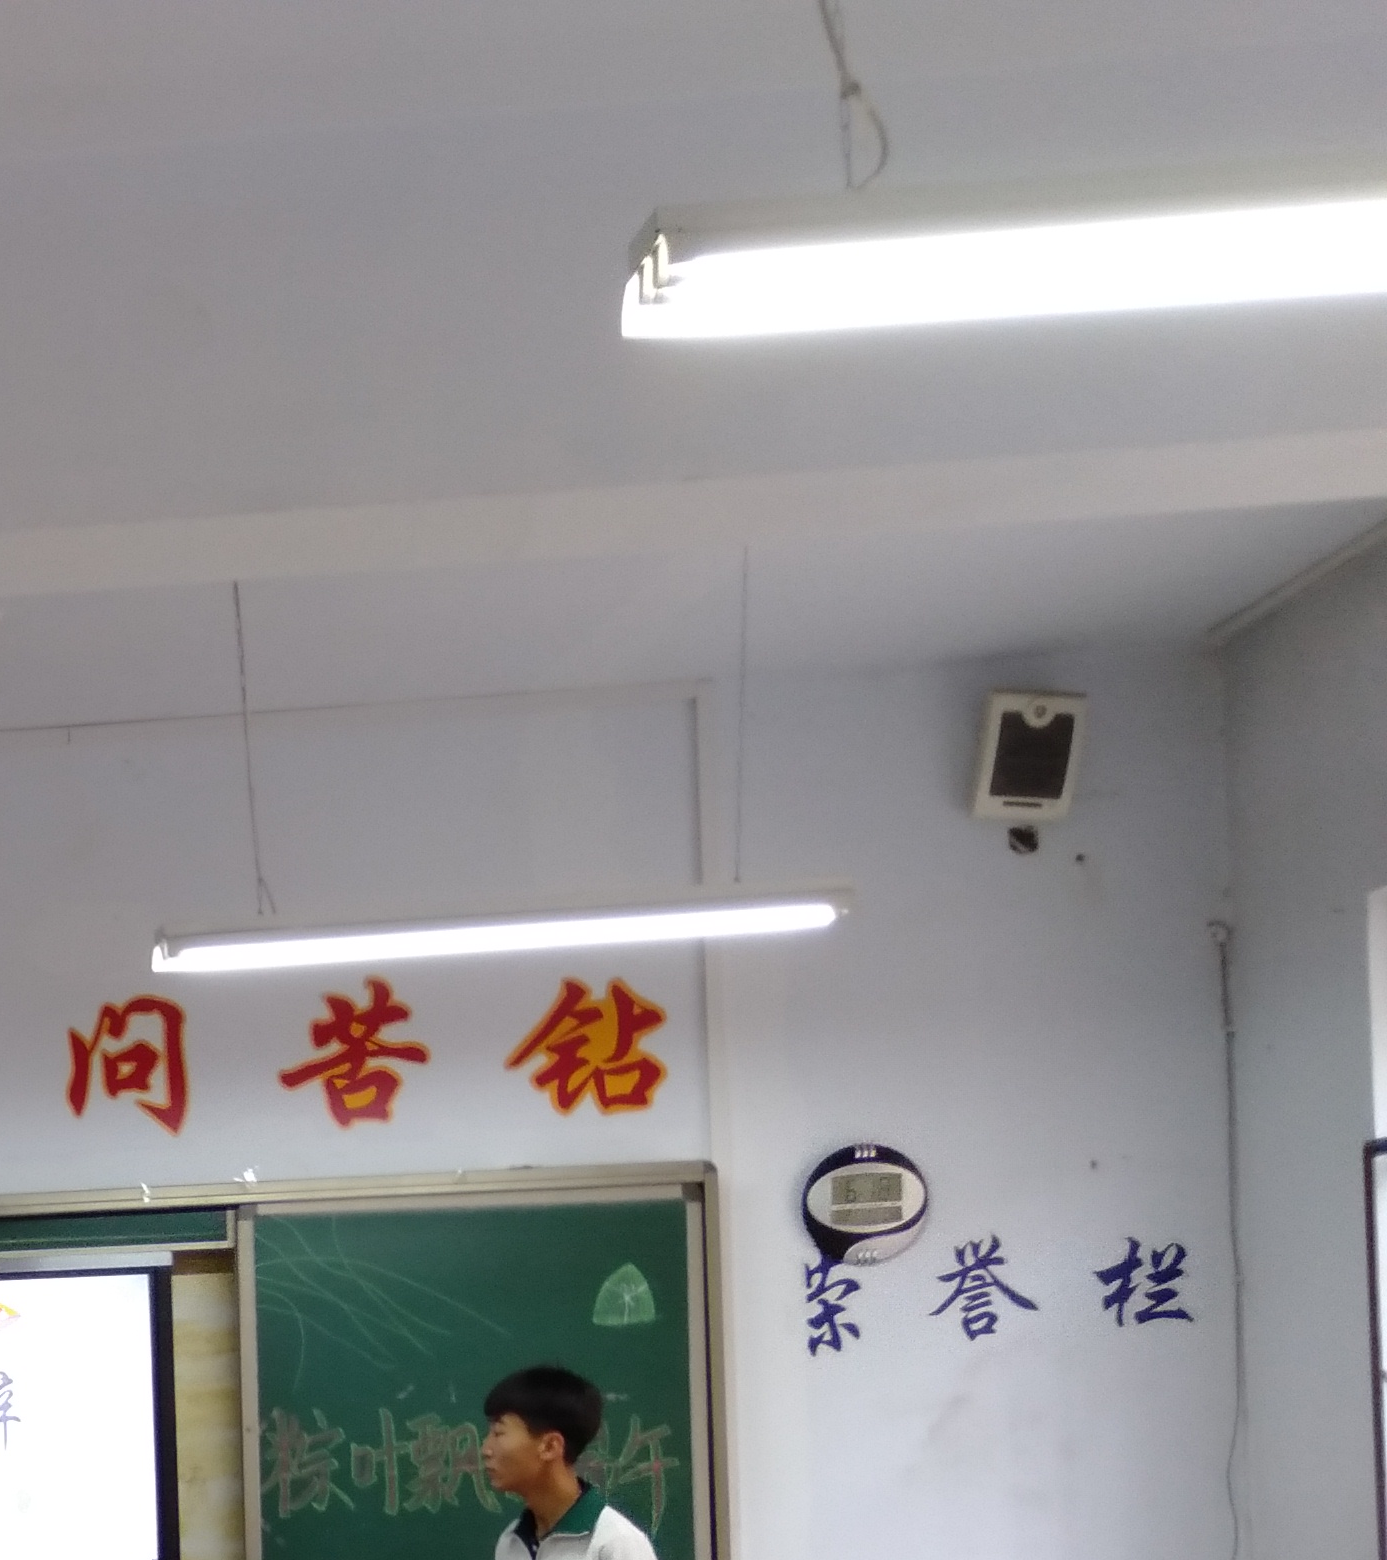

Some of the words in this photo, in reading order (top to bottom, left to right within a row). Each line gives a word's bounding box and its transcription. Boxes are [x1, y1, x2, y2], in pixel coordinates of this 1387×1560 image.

[803, 1235, 1195, 1356] 荣誉栏
[259, 1407, 679, 1541] 粽叶飘午
